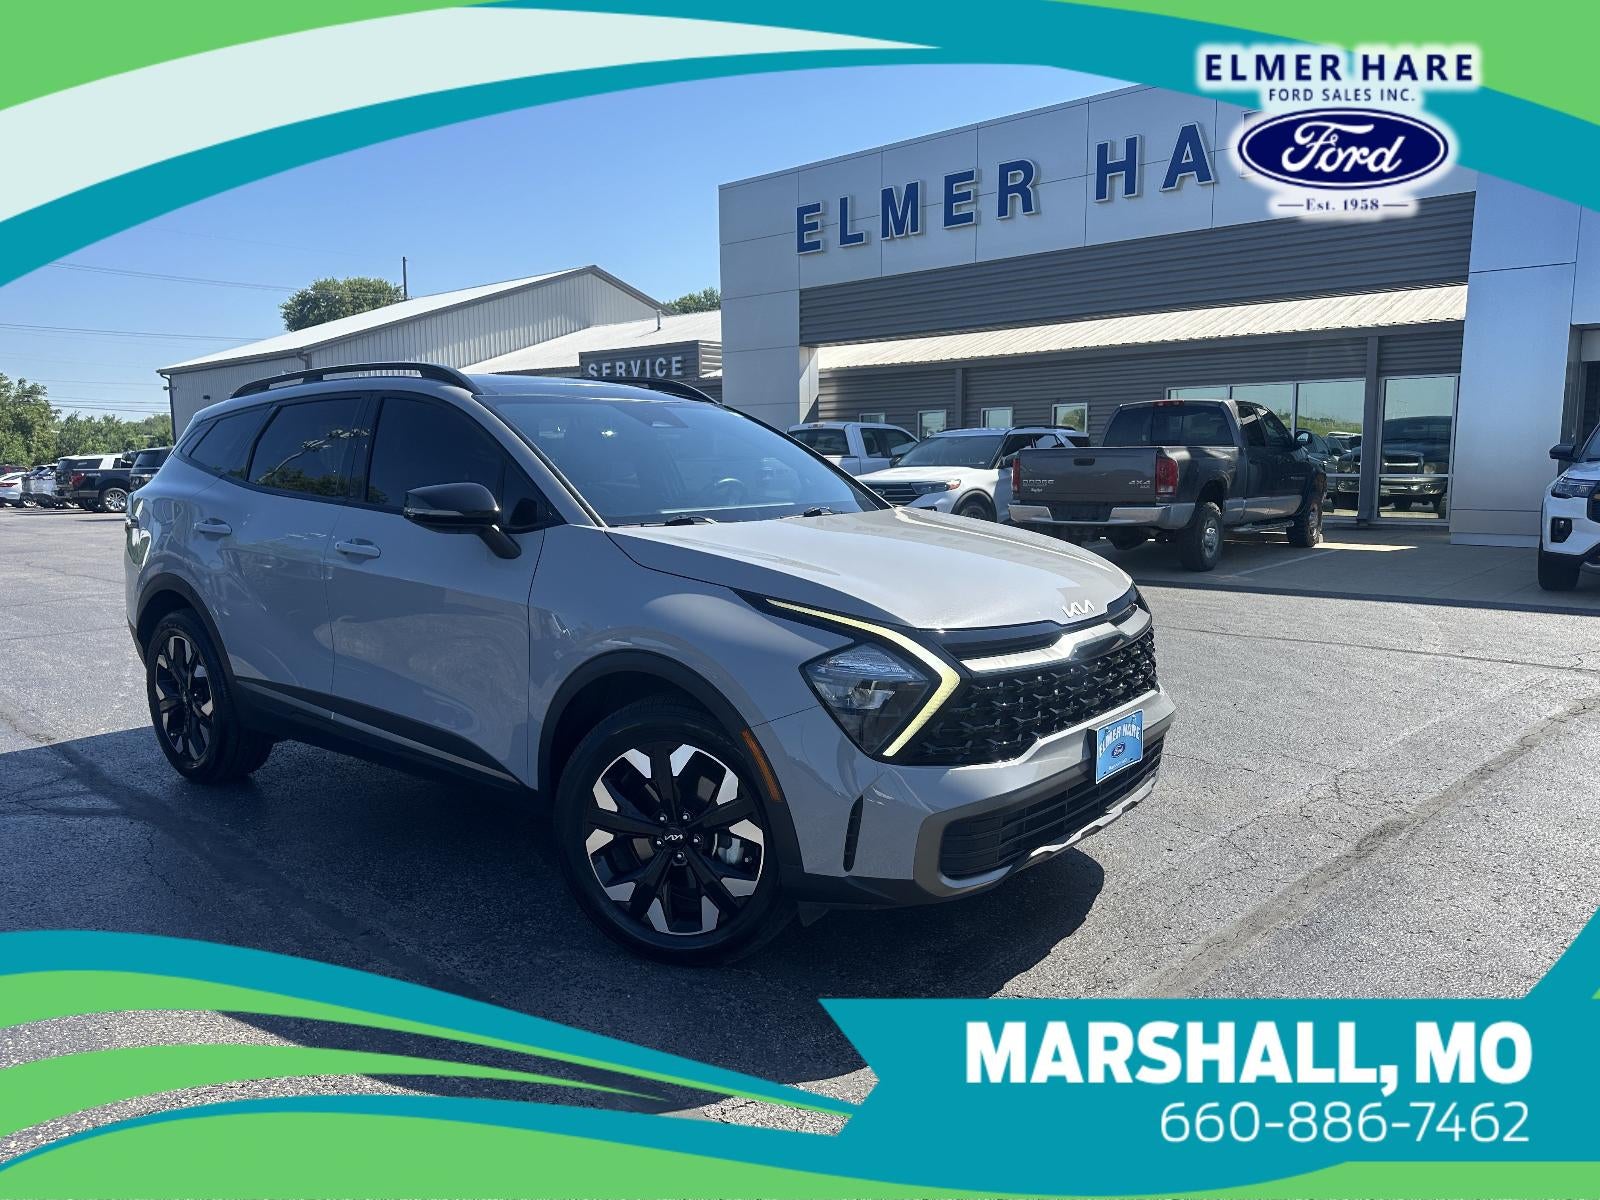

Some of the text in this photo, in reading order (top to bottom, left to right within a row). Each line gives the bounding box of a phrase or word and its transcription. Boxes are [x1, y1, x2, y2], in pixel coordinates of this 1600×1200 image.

[796, 111, 1262, 254] ELMER HA
[588, 355, 683, 378] SERVICE
[1061, 600, 1095, 618] KIA
[1099, 726, 1122, 758] ELMER
